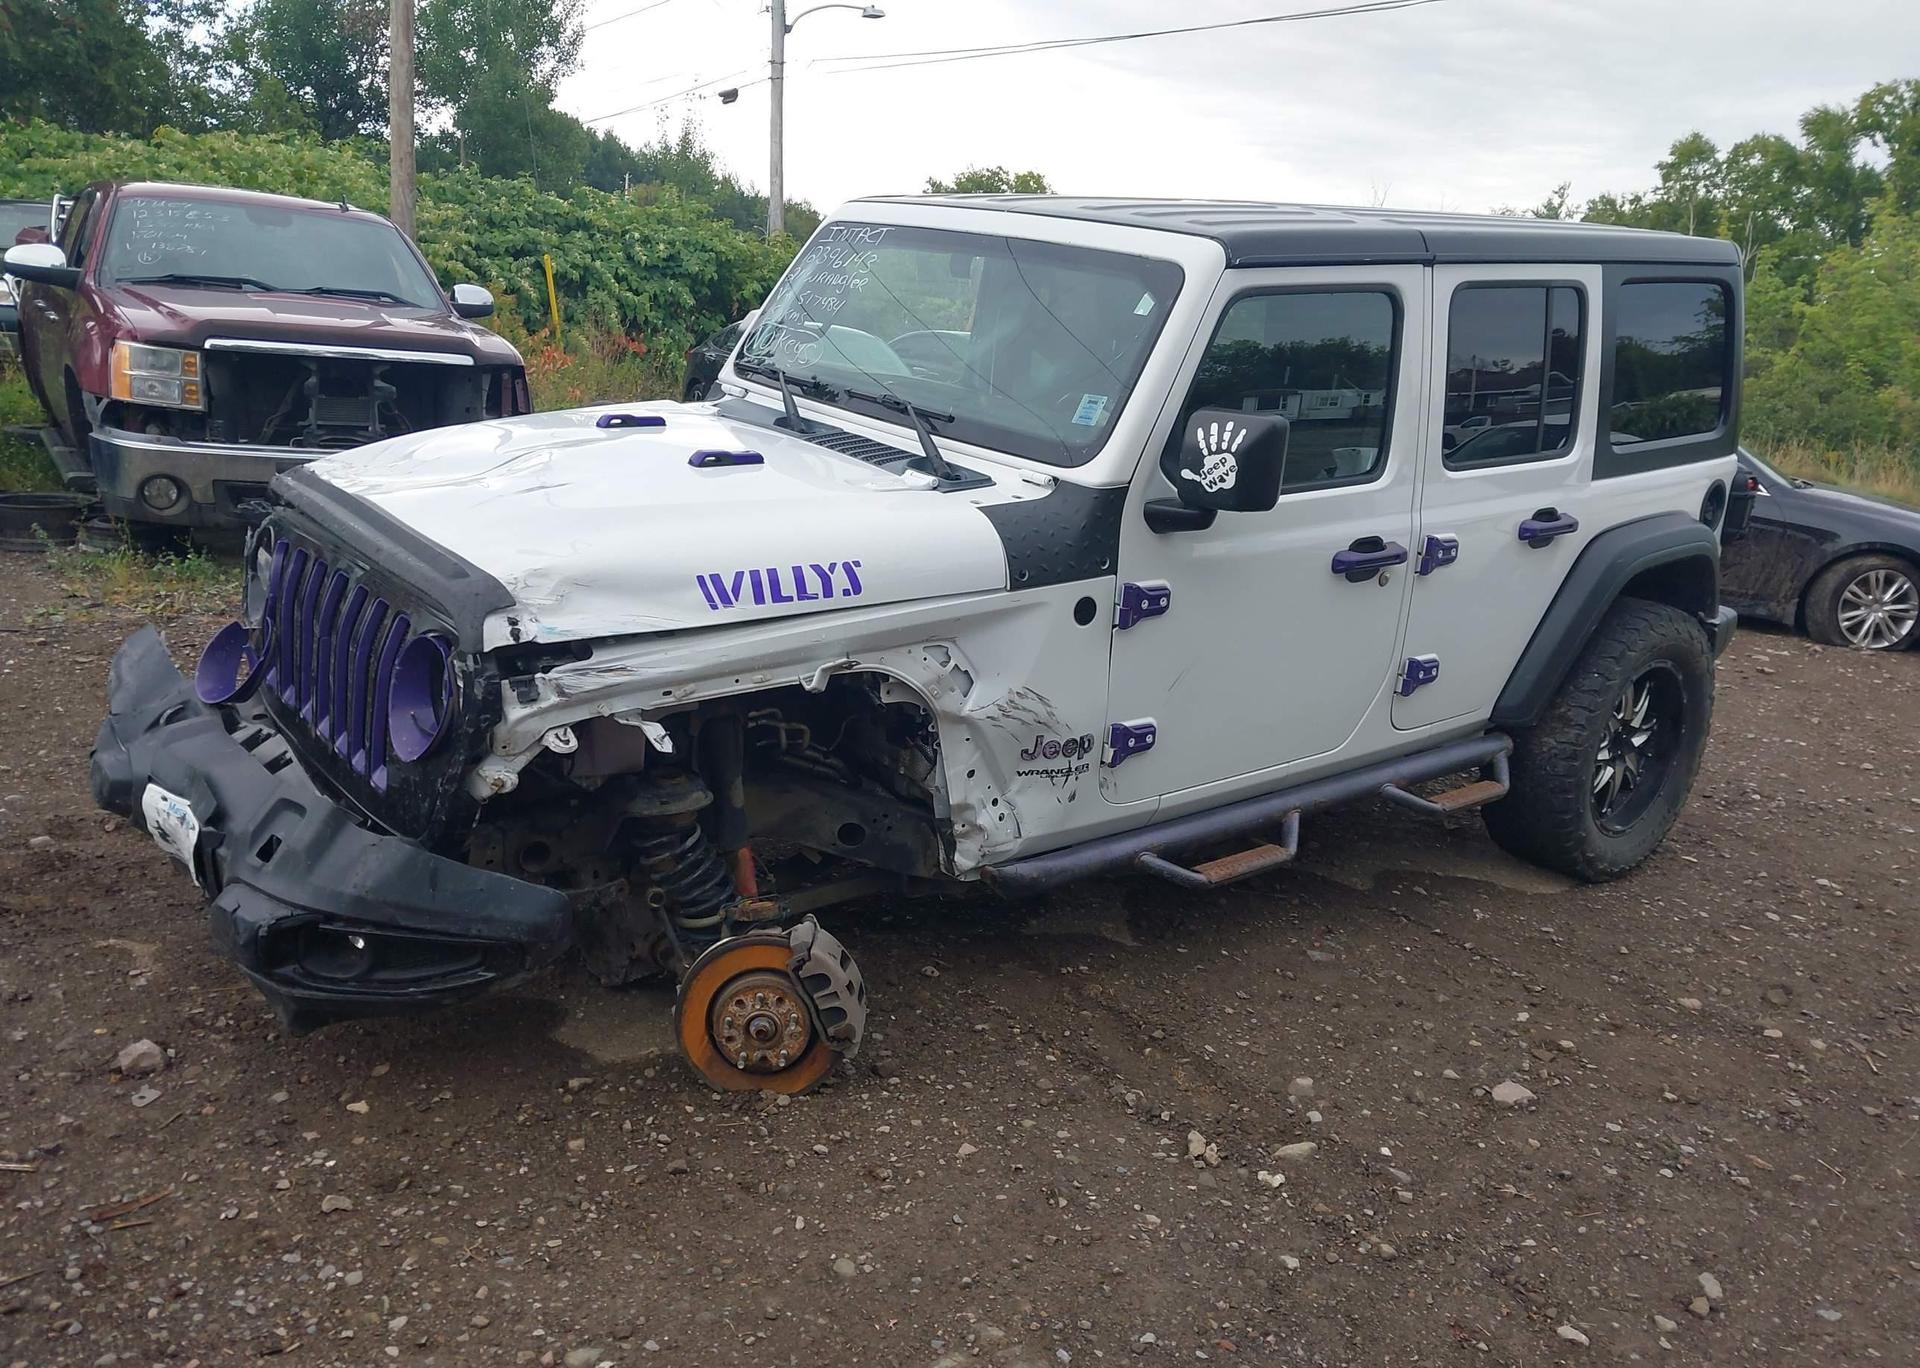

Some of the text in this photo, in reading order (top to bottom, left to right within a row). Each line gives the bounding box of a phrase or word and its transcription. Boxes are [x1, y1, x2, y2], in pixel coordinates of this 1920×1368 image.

[818, 226, 896, 246] INTACT
[1201, 456, 1227, 480] Jeep
[696, 560, 862, 611] WILLYS
[1020, 733, 1095, 761] Jeep
[1016, 762, 1090, 777] WRANGLER
